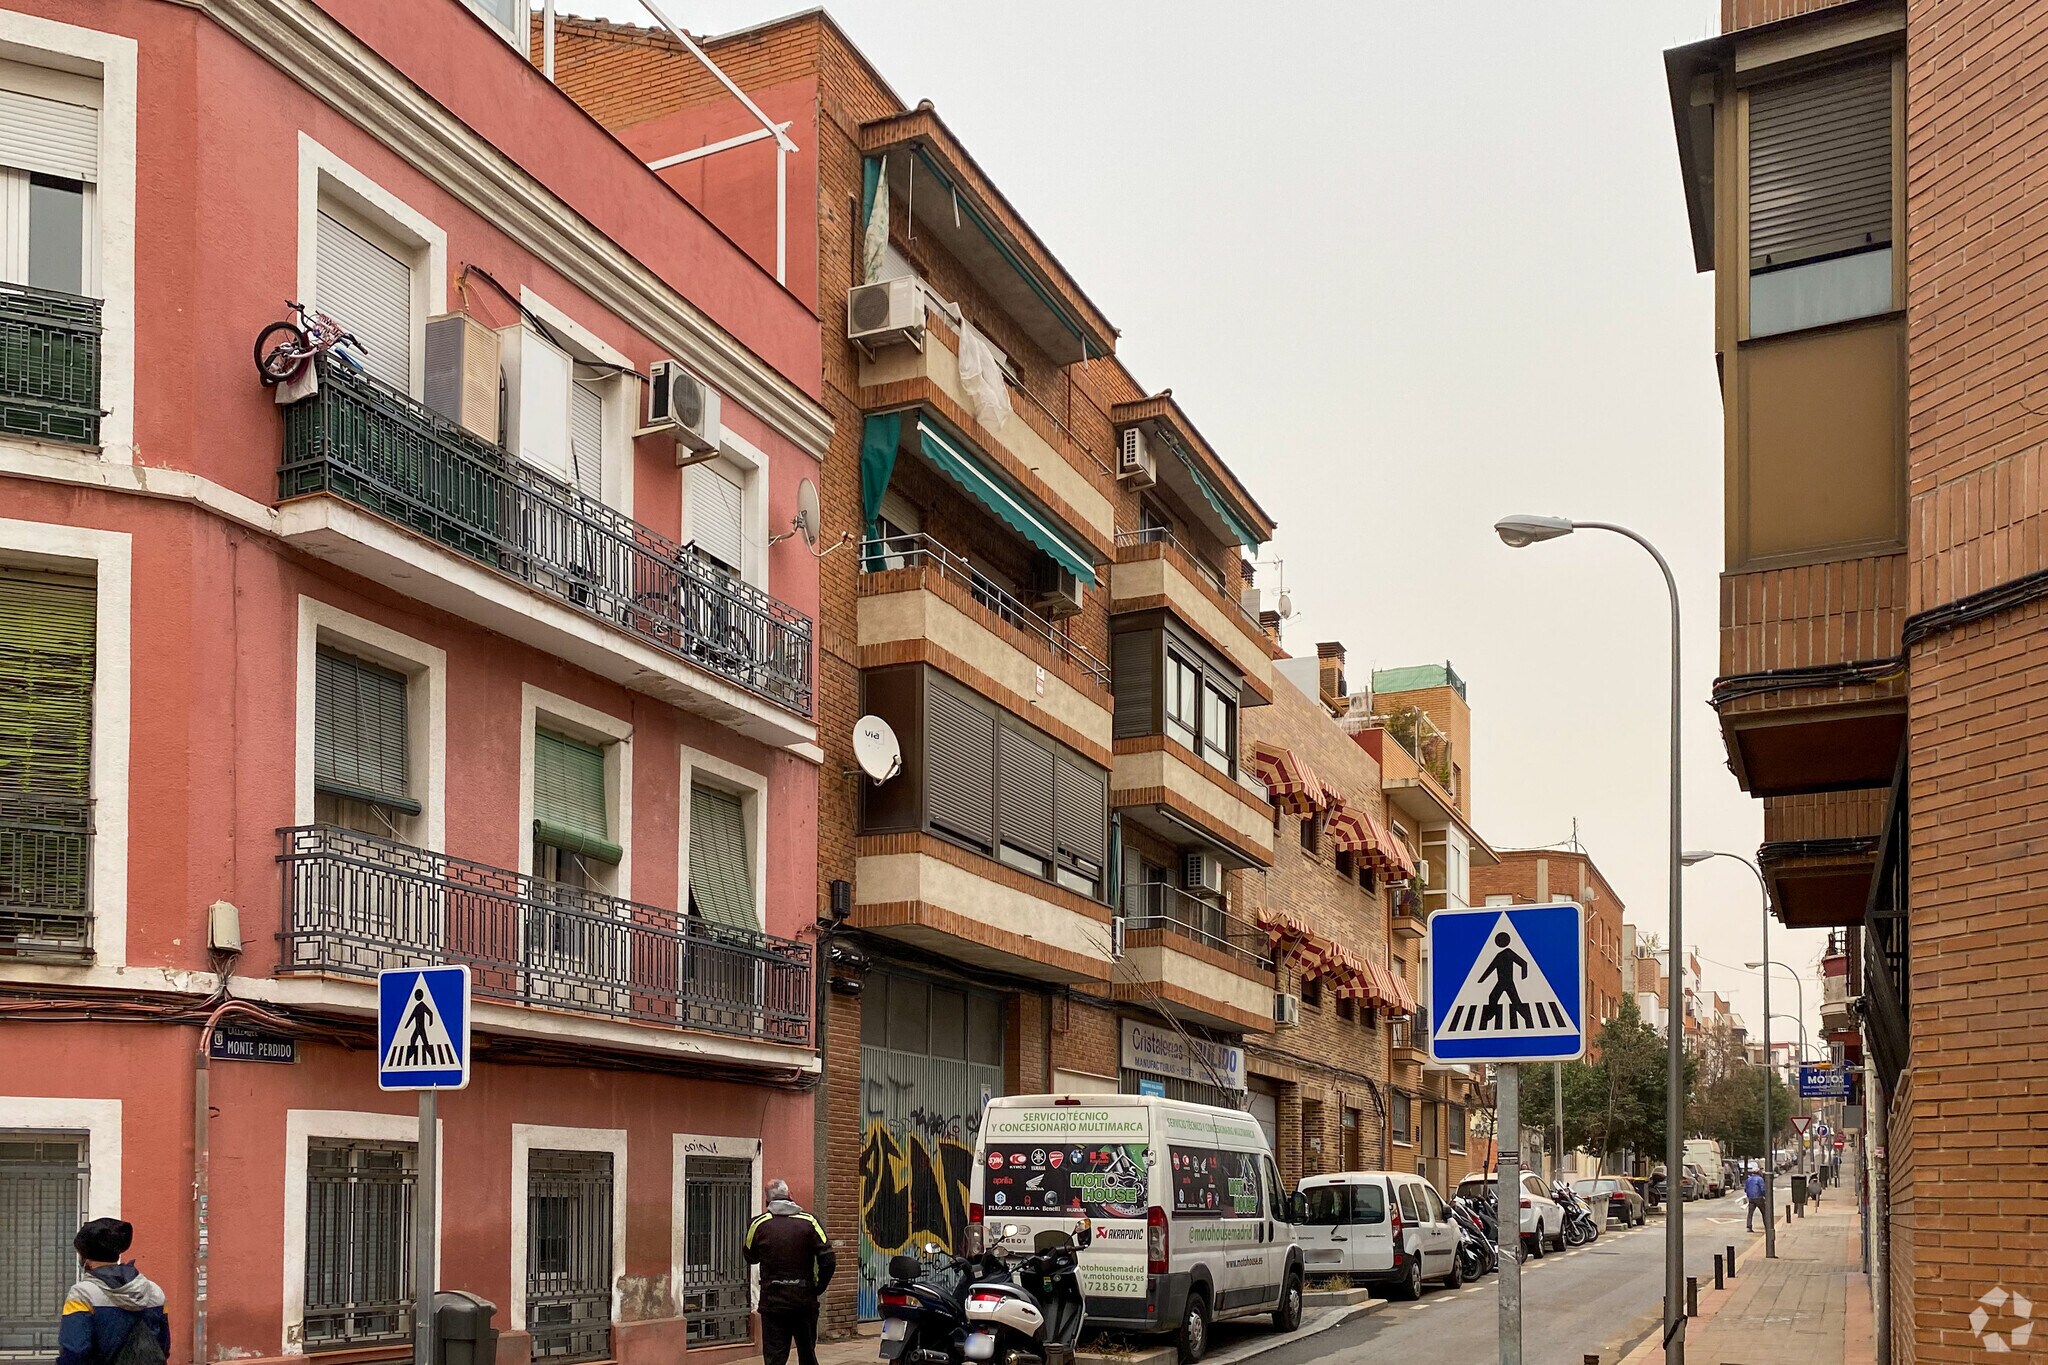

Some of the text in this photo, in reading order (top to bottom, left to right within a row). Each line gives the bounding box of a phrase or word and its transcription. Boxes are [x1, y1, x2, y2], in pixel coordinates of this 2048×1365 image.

[227, 1040, 292, 1058] MONTE PERDIDO
[1134, 1056, 1176, 1073] MANUFACTURAS
[1807, 1075, 1844, 1084] MOTOS
[1023, 1110, 1109, 1122] SERVICIO TÉCNICO
[991, 1122, 1143, 1132] Y CONCESIONARIO MULTIMARCA
[1082, 1187, 1137, 1203] HOUSE
[1189, 1223, 1253, 1244] @motohousemadrid
